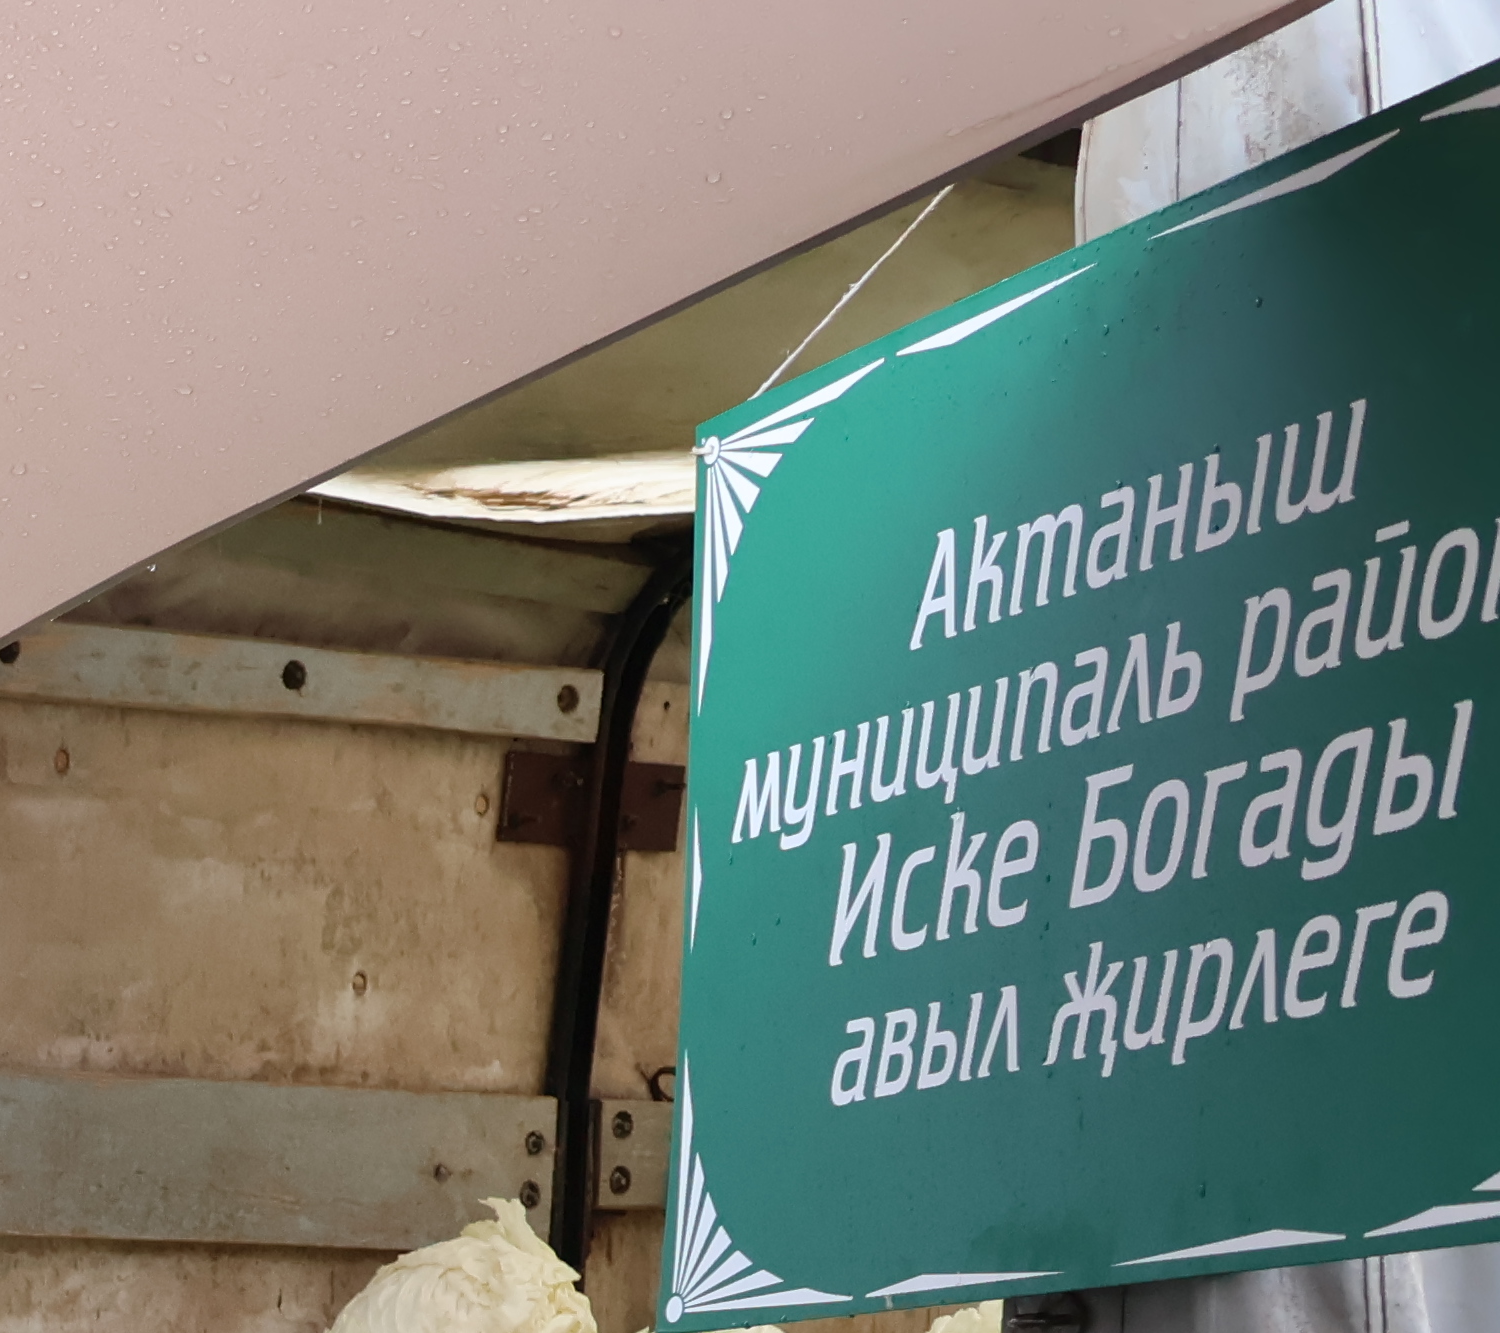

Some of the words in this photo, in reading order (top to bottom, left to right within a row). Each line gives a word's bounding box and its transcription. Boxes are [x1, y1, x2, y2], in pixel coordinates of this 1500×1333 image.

[909, 398, 1368, 650] Актаныш
[731, 620, 1202, 850] муниципаль
[828, 810, 1039, 967] Иске
[1068, 699, 1473, 910] Богады
[830, 985, 1020, 1107] авыл
[1041, 890, 1449, 1077] җирлеге
